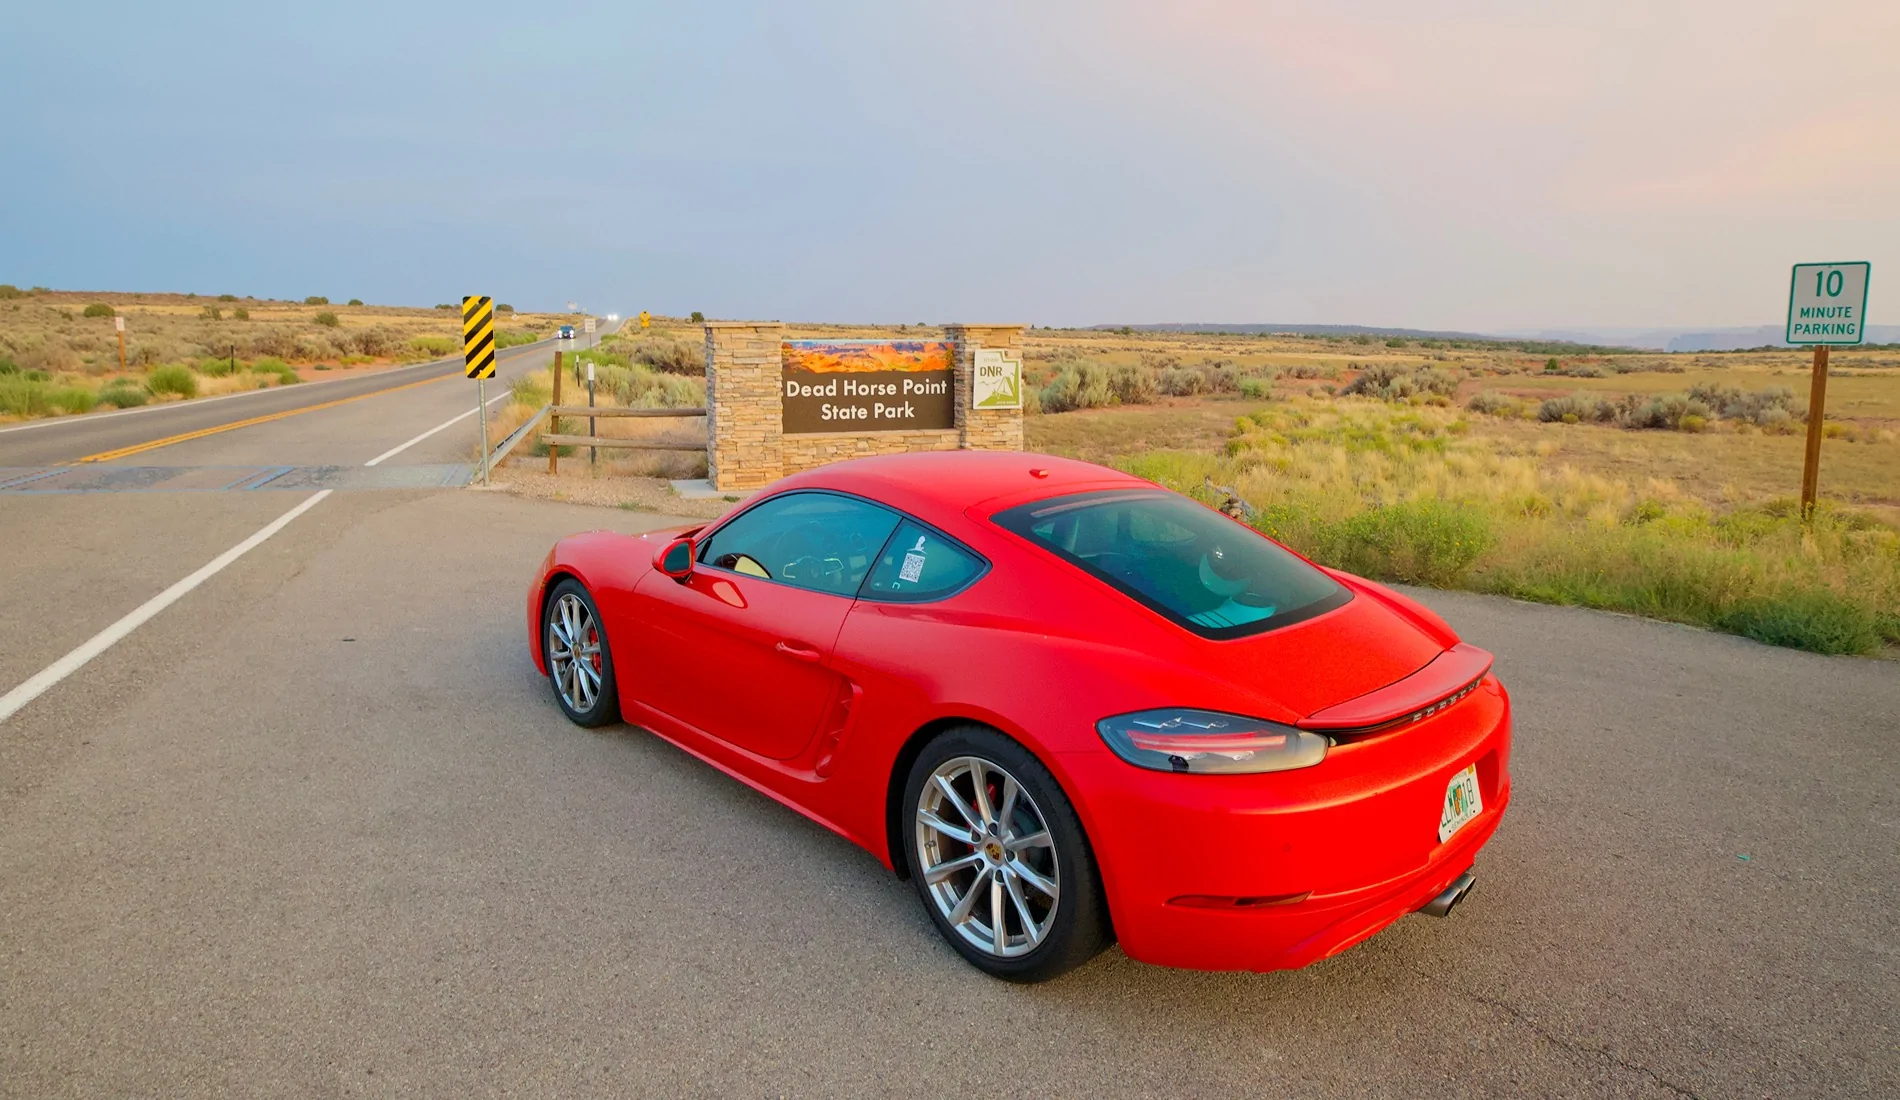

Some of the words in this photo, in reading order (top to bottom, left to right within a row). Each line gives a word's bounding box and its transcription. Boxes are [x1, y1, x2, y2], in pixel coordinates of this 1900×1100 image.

[1816, 270, 1844, 297] 10
[1800, 306, 1852, 319] MINUTE
[1794, 323, 1856, 335] PARKING
[980, 365, 1003, 377] DNR
[786, 379, 837, 397] Dead
[843, 380, 897, 396] Horse
[903, 378, 947, 395] Point
[821, 403, 868, 420] State
[874, 401, 915, 419] Park
